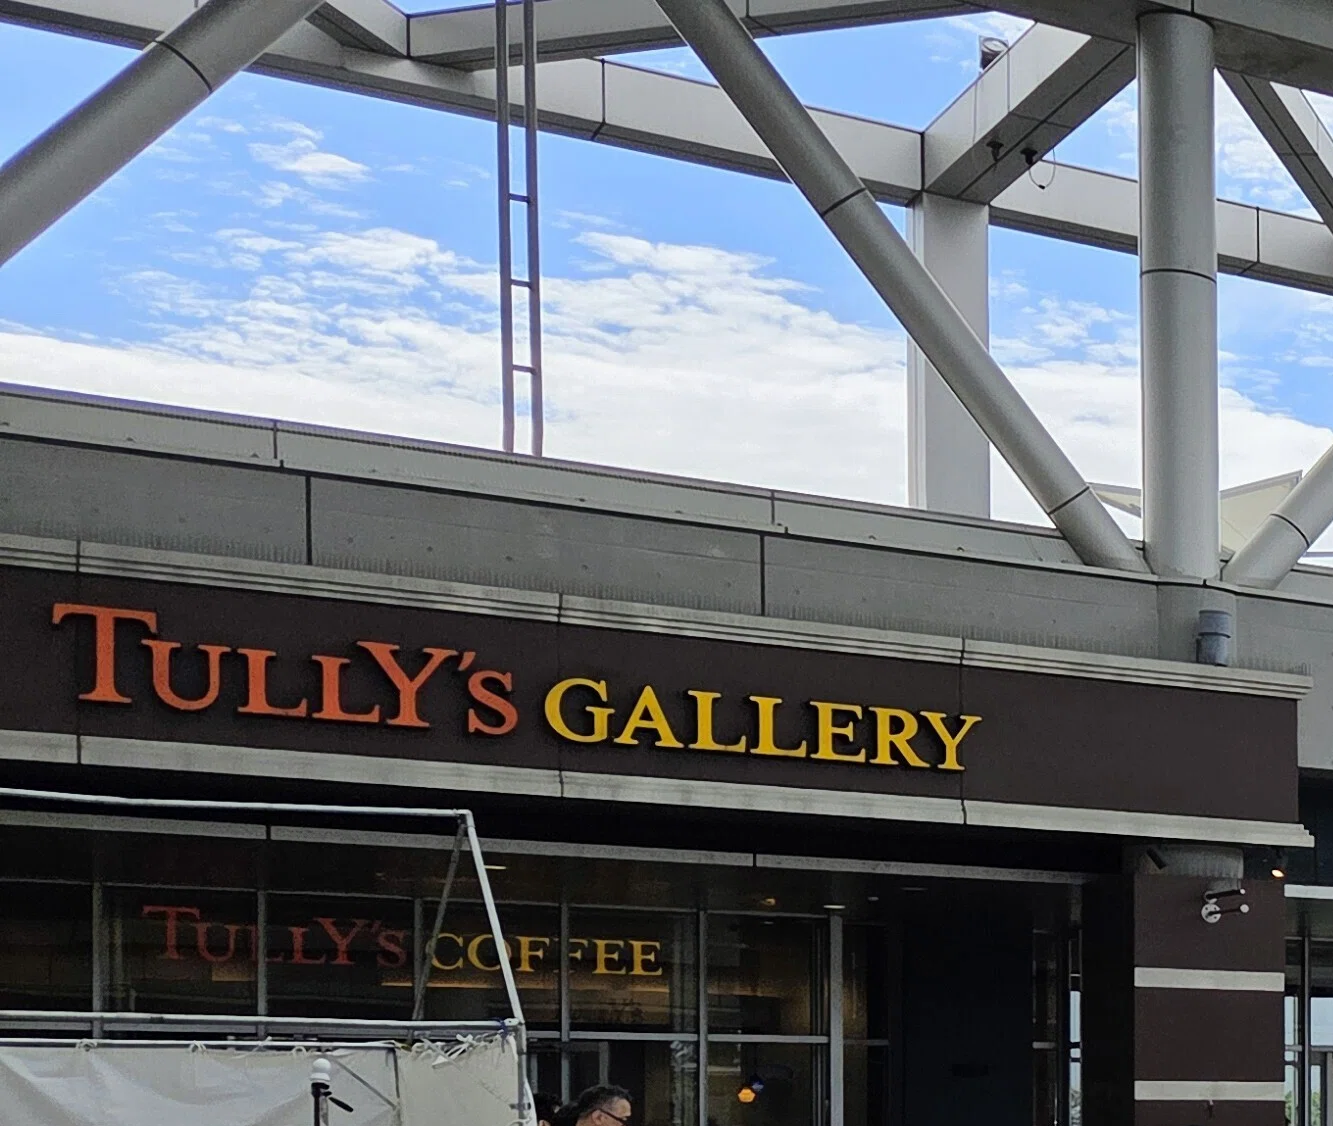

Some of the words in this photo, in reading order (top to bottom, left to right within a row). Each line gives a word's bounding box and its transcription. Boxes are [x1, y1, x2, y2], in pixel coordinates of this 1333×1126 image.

[52, 602, 518, 735] TULLY'S
[544, 677, 983, 771] GALLERY
[425, 932, 664, 977] COFFEE
